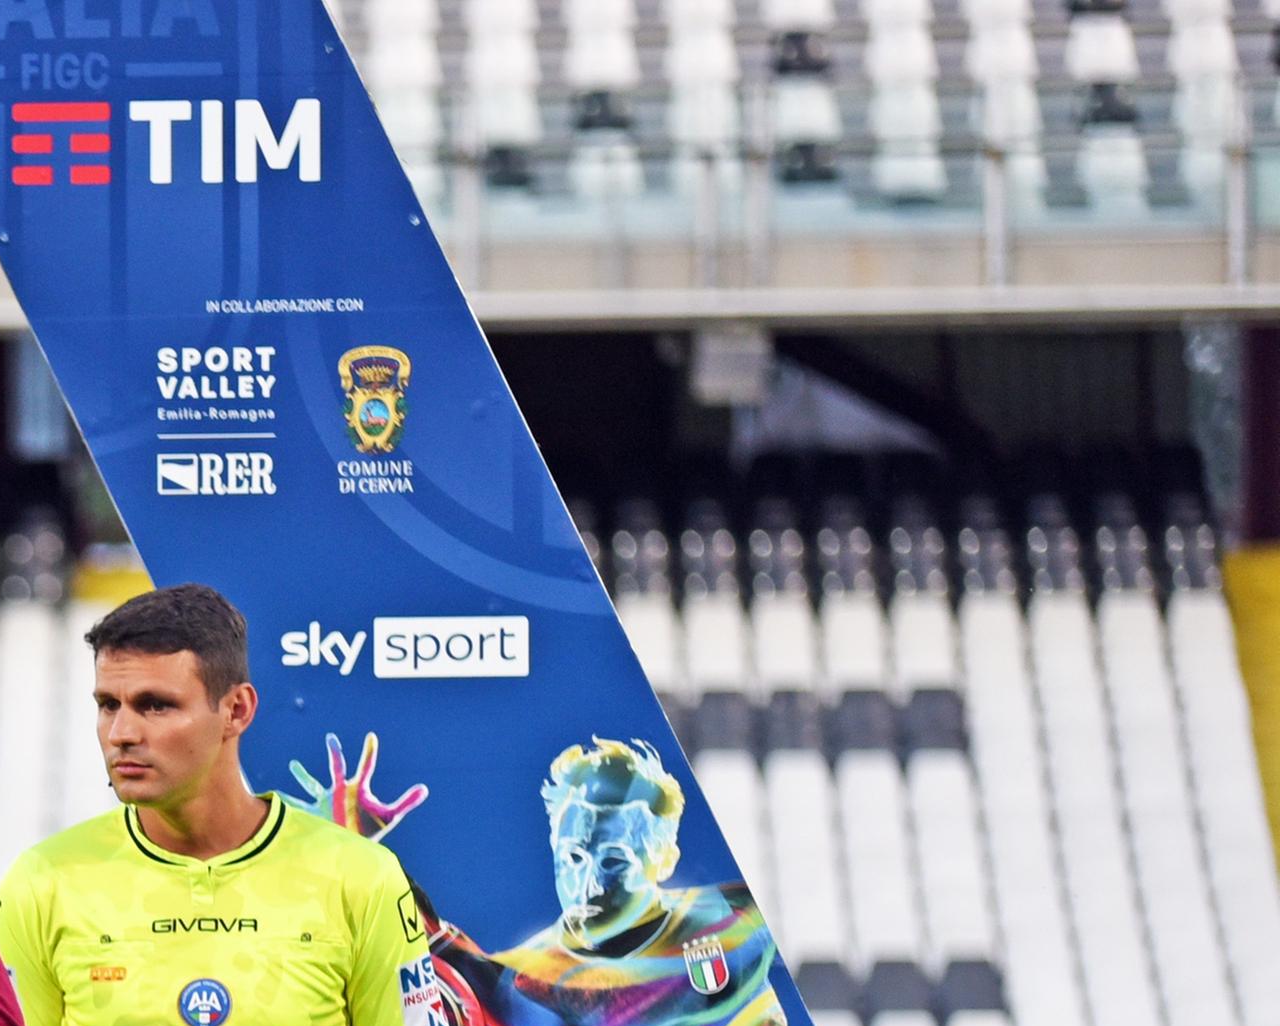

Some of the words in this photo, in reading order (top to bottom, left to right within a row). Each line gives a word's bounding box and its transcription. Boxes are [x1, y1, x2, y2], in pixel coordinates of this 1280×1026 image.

[20, 52, 111, 91] FIGC
[129, 98, 321, 184] TIM
[206, 299, 220, 313] IN
[221, 298, 335, 313] COLLABORAZIONE
[336, 297, 364, 312] CON
[157, 346, 276, 373] SPORT
[157, 375, 276, 399] VALLEY
[157, 406, 276, 422] Emilia-Romagna
[199, 452, 277, 495] RER
[337, 460, 414, 477] COMUNE
[339, 478, 356, 494] DI
[358, 477, 414, 494] CERVIA
[280, 620, 367, 675] sky
[386, 627, 517, 670] sport
[151, 918, 258, 933] GIVOVA
[400, 956, 432, 993] NE
[187, 991, 222, 1011] AIA
[404, 987, 440, 1008] INSUR
